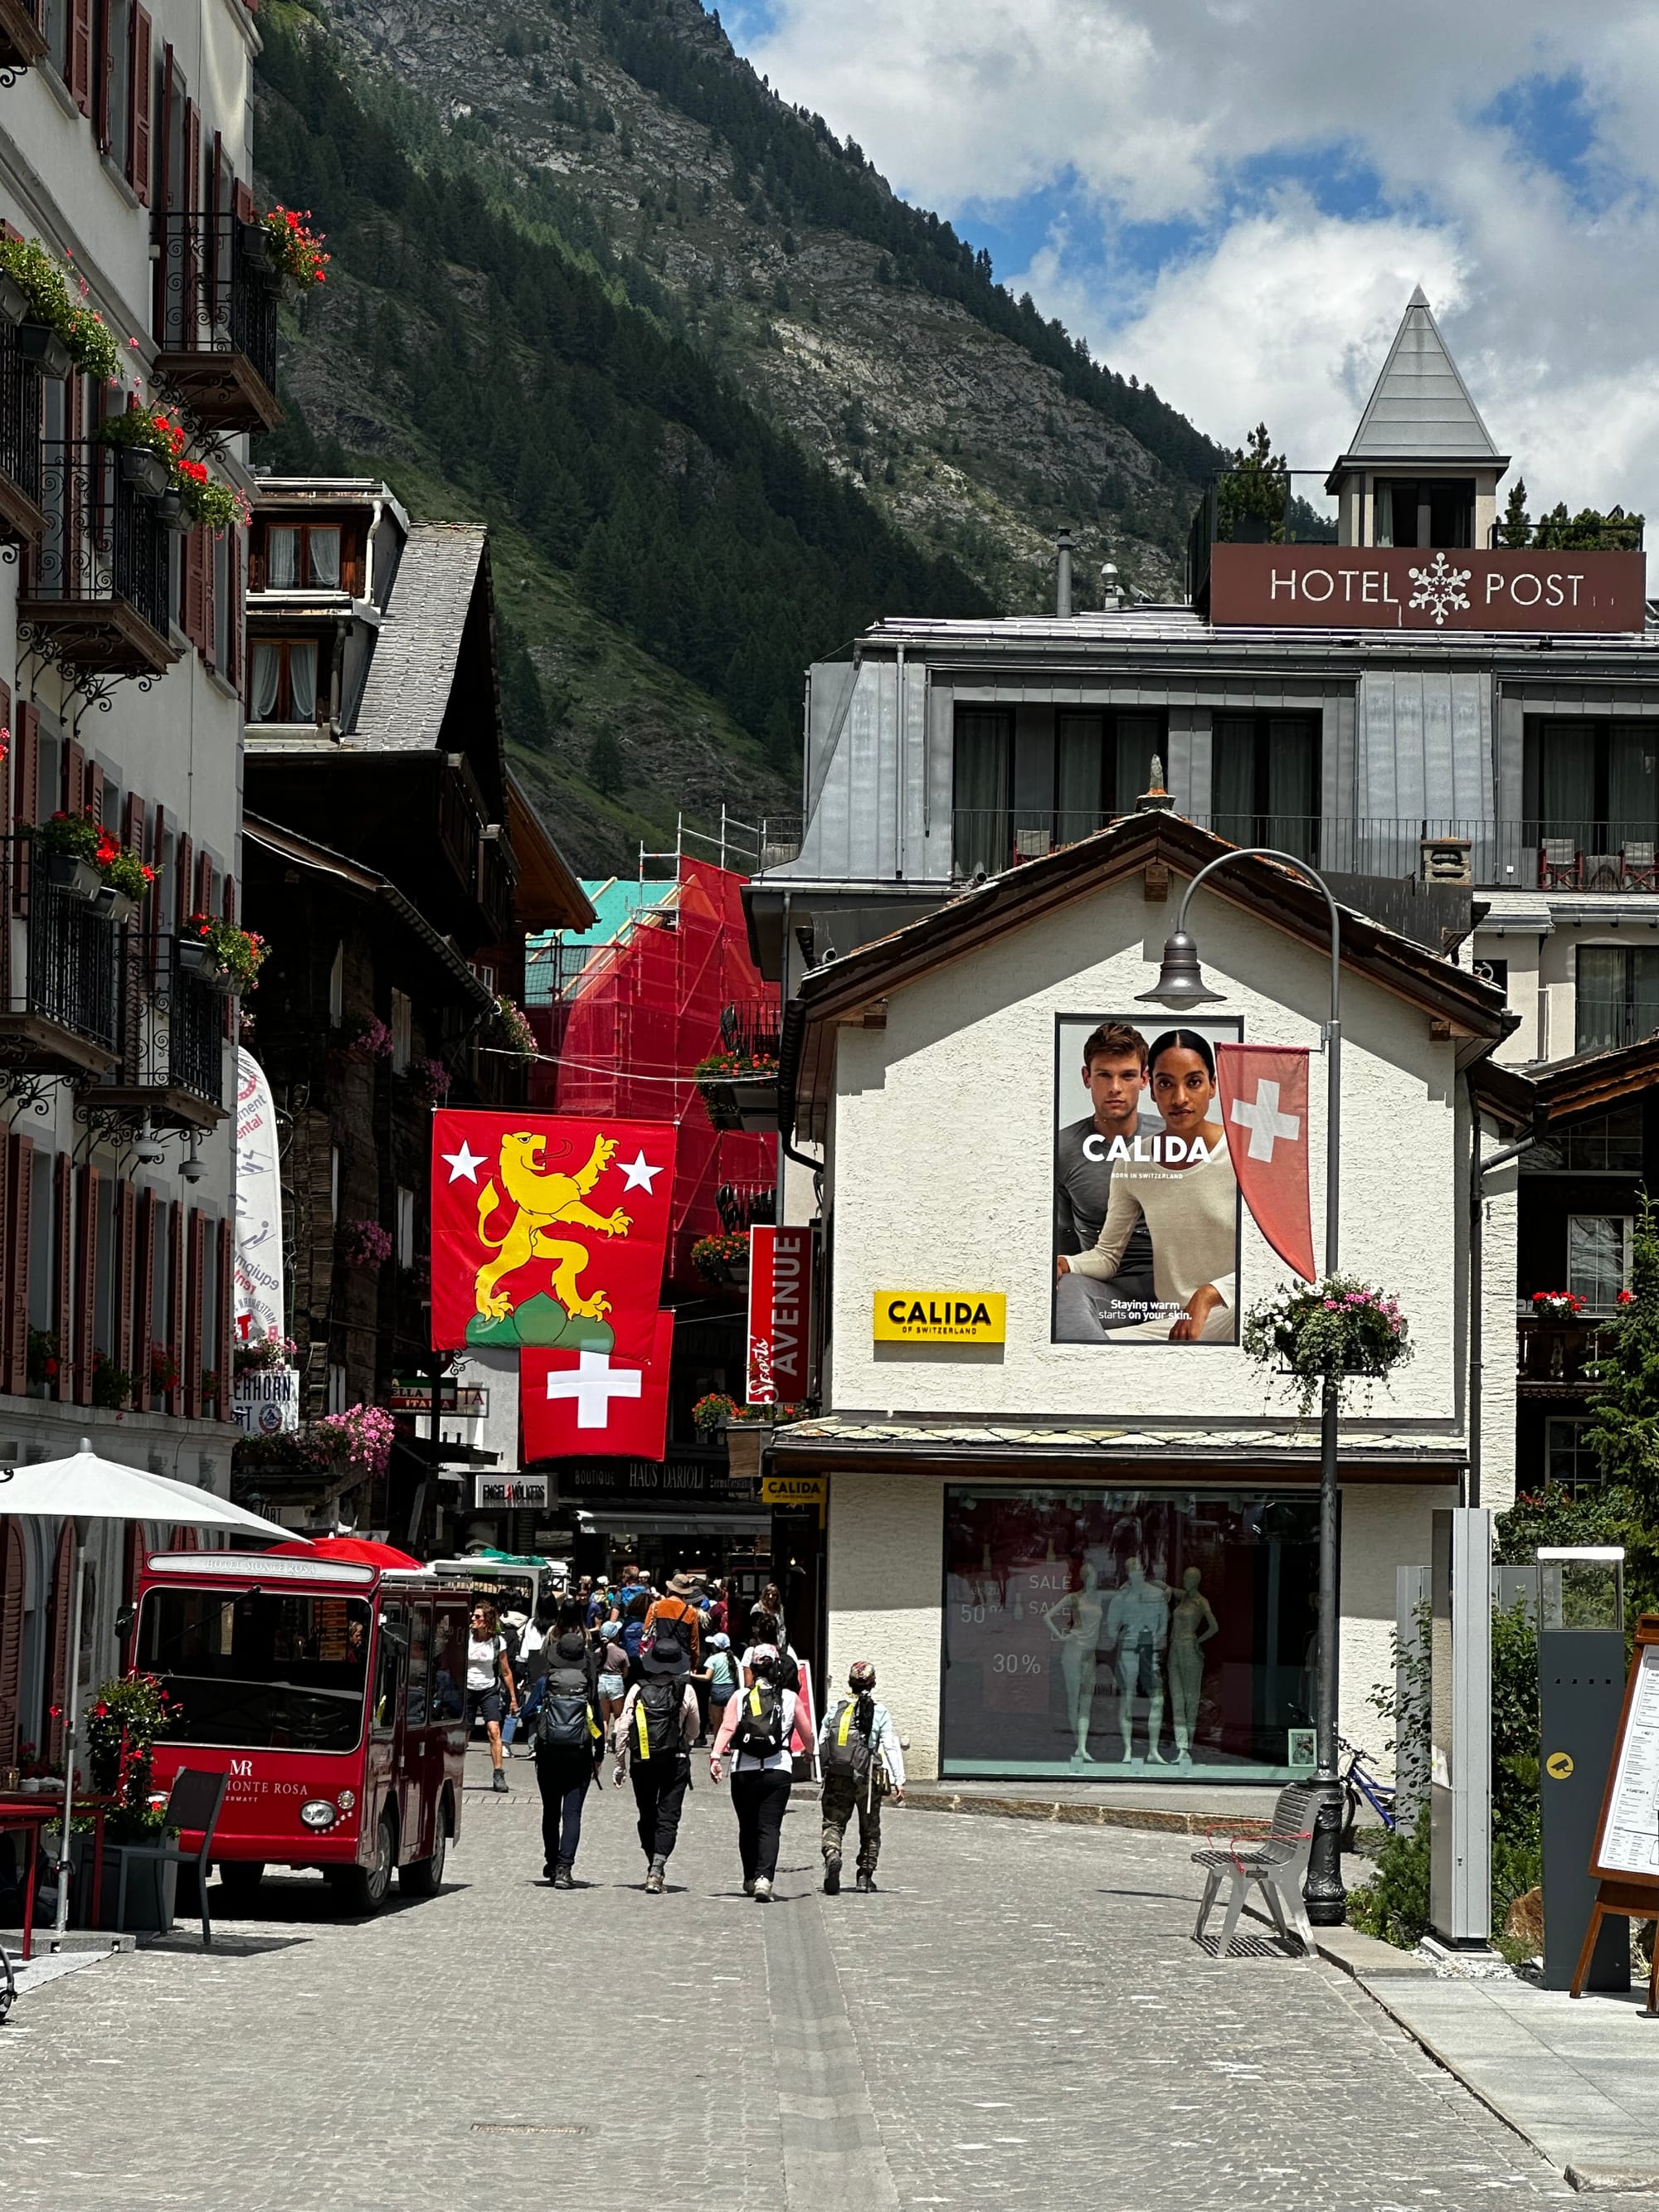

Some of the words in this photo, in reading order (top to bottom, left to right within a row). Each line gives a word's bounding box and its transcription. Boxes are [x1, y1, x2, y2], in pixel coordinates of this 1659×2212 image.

[1270, 569, 1399, 604] HOTEL
[1485, 573, 1584, 606] POST
[236, 1094, 266, 1123] ment
[1082, 1134, 1212, 1164] CALIDA
[770, 1237, 801, 1377] AVENUE
[888, 1300, 992, 1326] CALIDA
[1111, 1299, 1148, 1311] Staying
[1150, 1300, 1180, 1310] warm
[1098, 1310, 1126, 1320] starts
[1128, 1310, 1141, 1320] on
[1144, 1310, 1166, 1321] your
[1167, 1310, 1193, 1320] skin.
[916, 1326, 977, 1335] SWITZERLAND
[575, 1469, 615, 1485] BOUTIQUE
[629, 1463, 658, 1487] HAUS
[663, 1465, 703, 1490] DARIOLI
[767, 1480, 820, 1494] CALIDA
[206, 1558, 241, 1569] HOTEL
[246, 1560, 285, 1573] MONTE
[287, 1563, 316, 1575] ROSA
[1029, 1574, 1073, 1590] SALE
[229, 1759, 253, 1777] MR
[273, 1782, 309, 1796] ROSA
